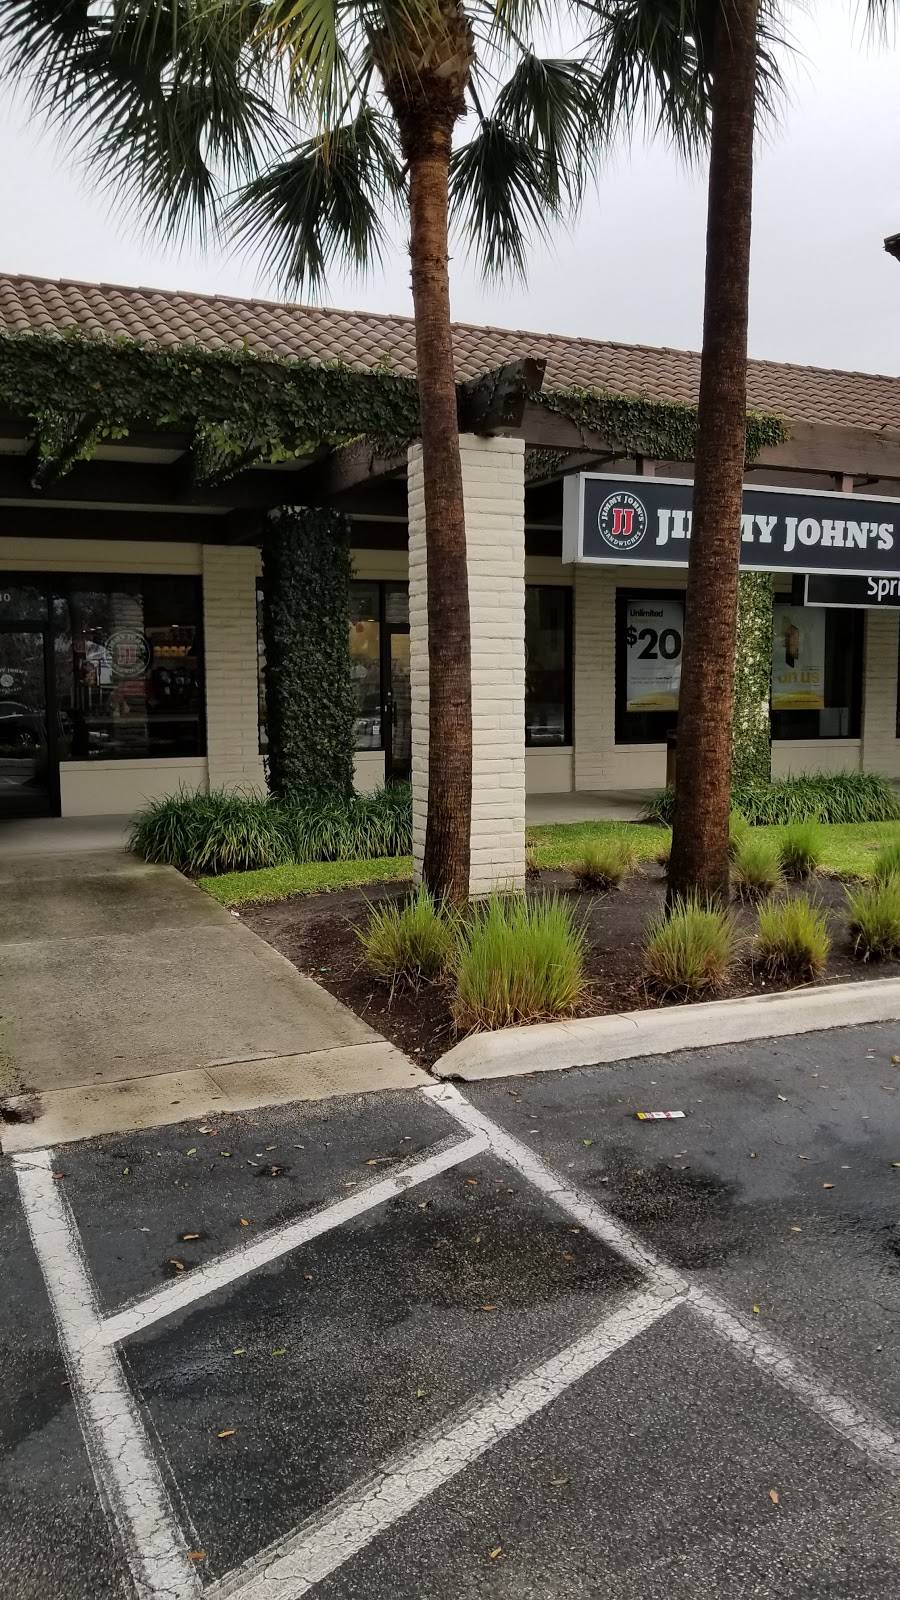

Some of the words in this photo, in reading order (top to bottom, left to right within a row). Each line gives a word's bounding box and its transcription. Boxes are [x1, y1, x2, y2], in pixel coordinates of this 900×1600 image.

[601, 495, 622, 521] JIMMY
[624, 495, 645, 523] JOHN'S
[612, 508, 634, 535] JJ
[603, 529, 641, 546] SANDWICHES
[656, 509, 778, 546] JIY
[784, 517, 894, 552] JOHN'S
[630, 608, 664, 617] Unlimited
[625, 624, 682, 659] $20
